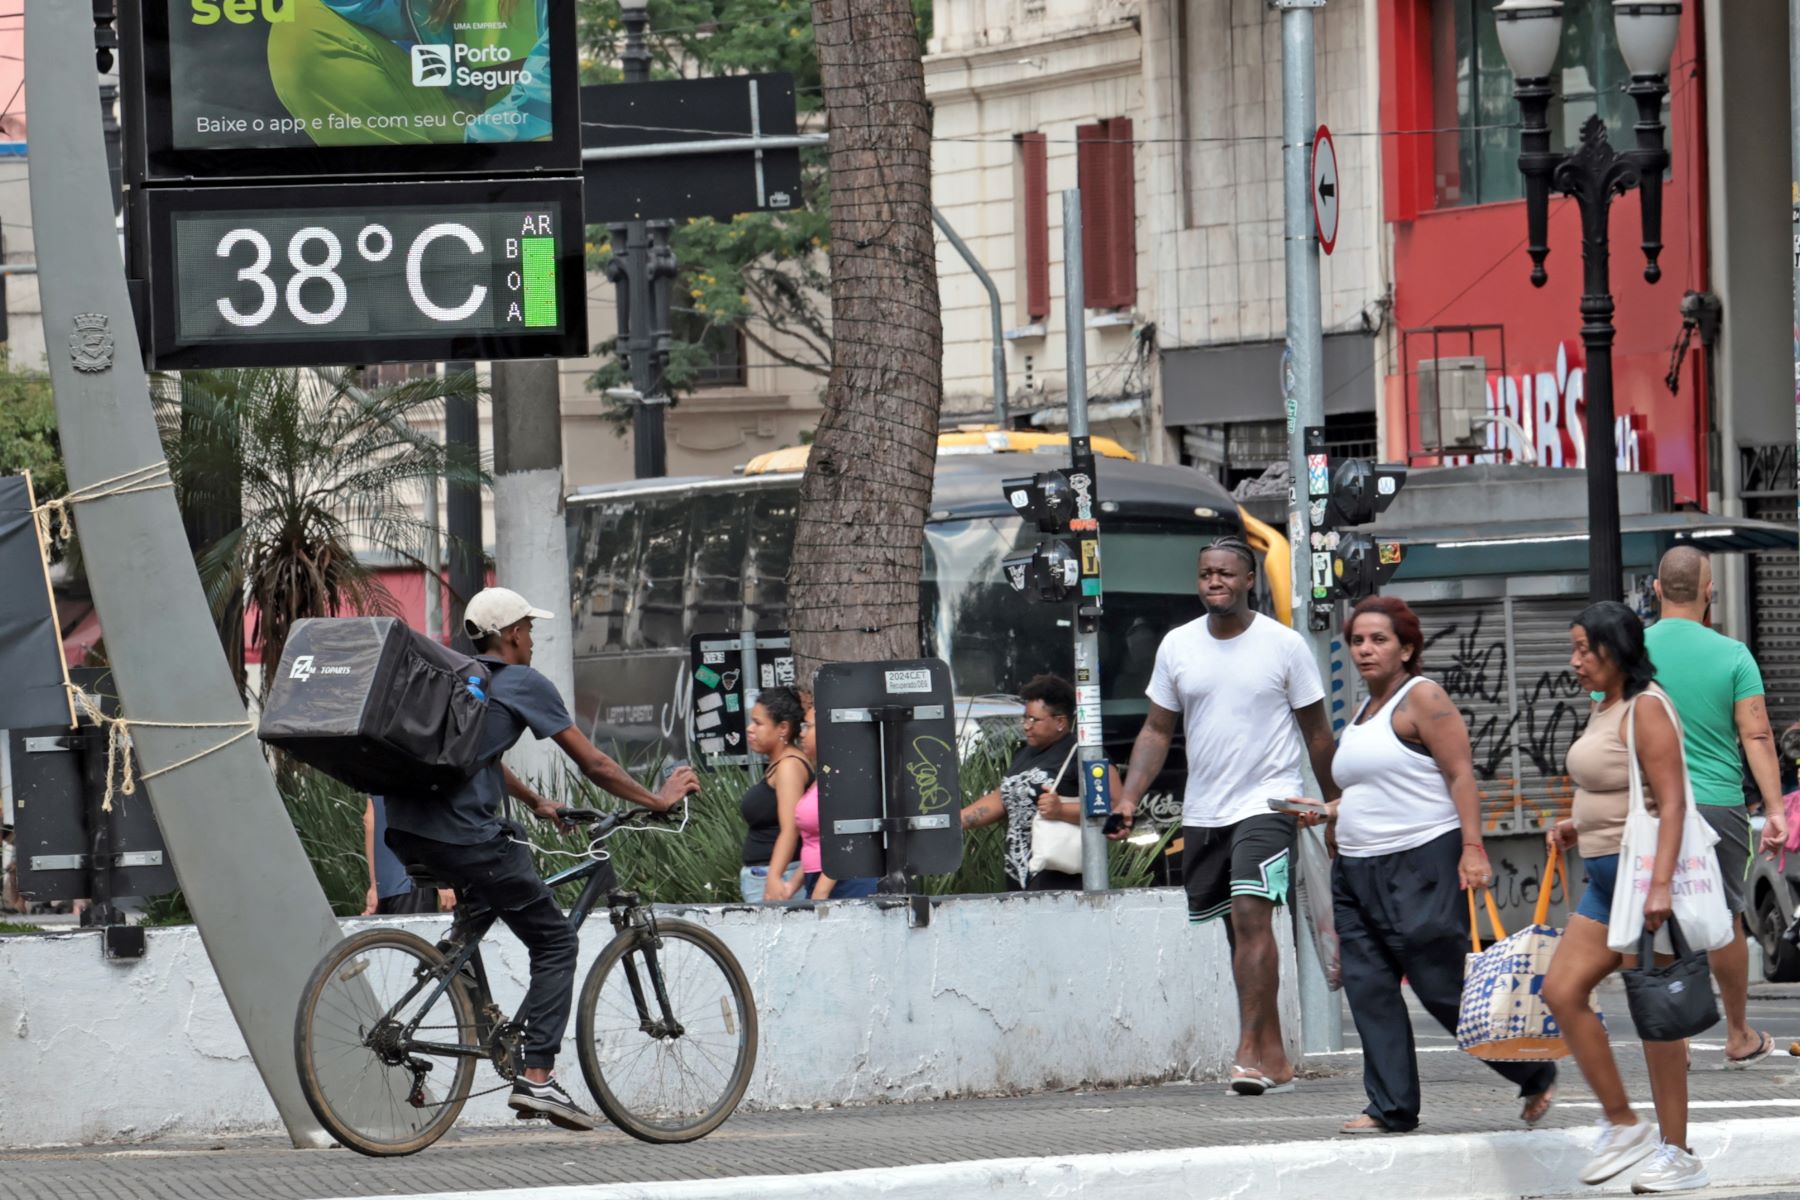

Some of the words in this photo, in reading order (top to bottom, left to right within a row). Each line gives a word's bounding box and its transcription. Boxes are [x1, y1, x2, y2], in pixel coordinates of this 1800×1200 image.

[191, 0, 295, 25] seu
[472, 22, 507, 30] EMPRESA
[454, 44, 511, 63] Porto
[456, 67, 532, 91] Seguro
[197, 116, 247, 132] Baixe
[252, 119, 264, 131] o
[269, 117, 306, 133] app
[311, 118, 323, 129] e
[328, 113, 362, 129] fale
[367, 116, 408, 128] com
[414, 115, 446, 127] seu
[452, 110, 528, 127] Corretor
[521, 215, 552, 235] AR
